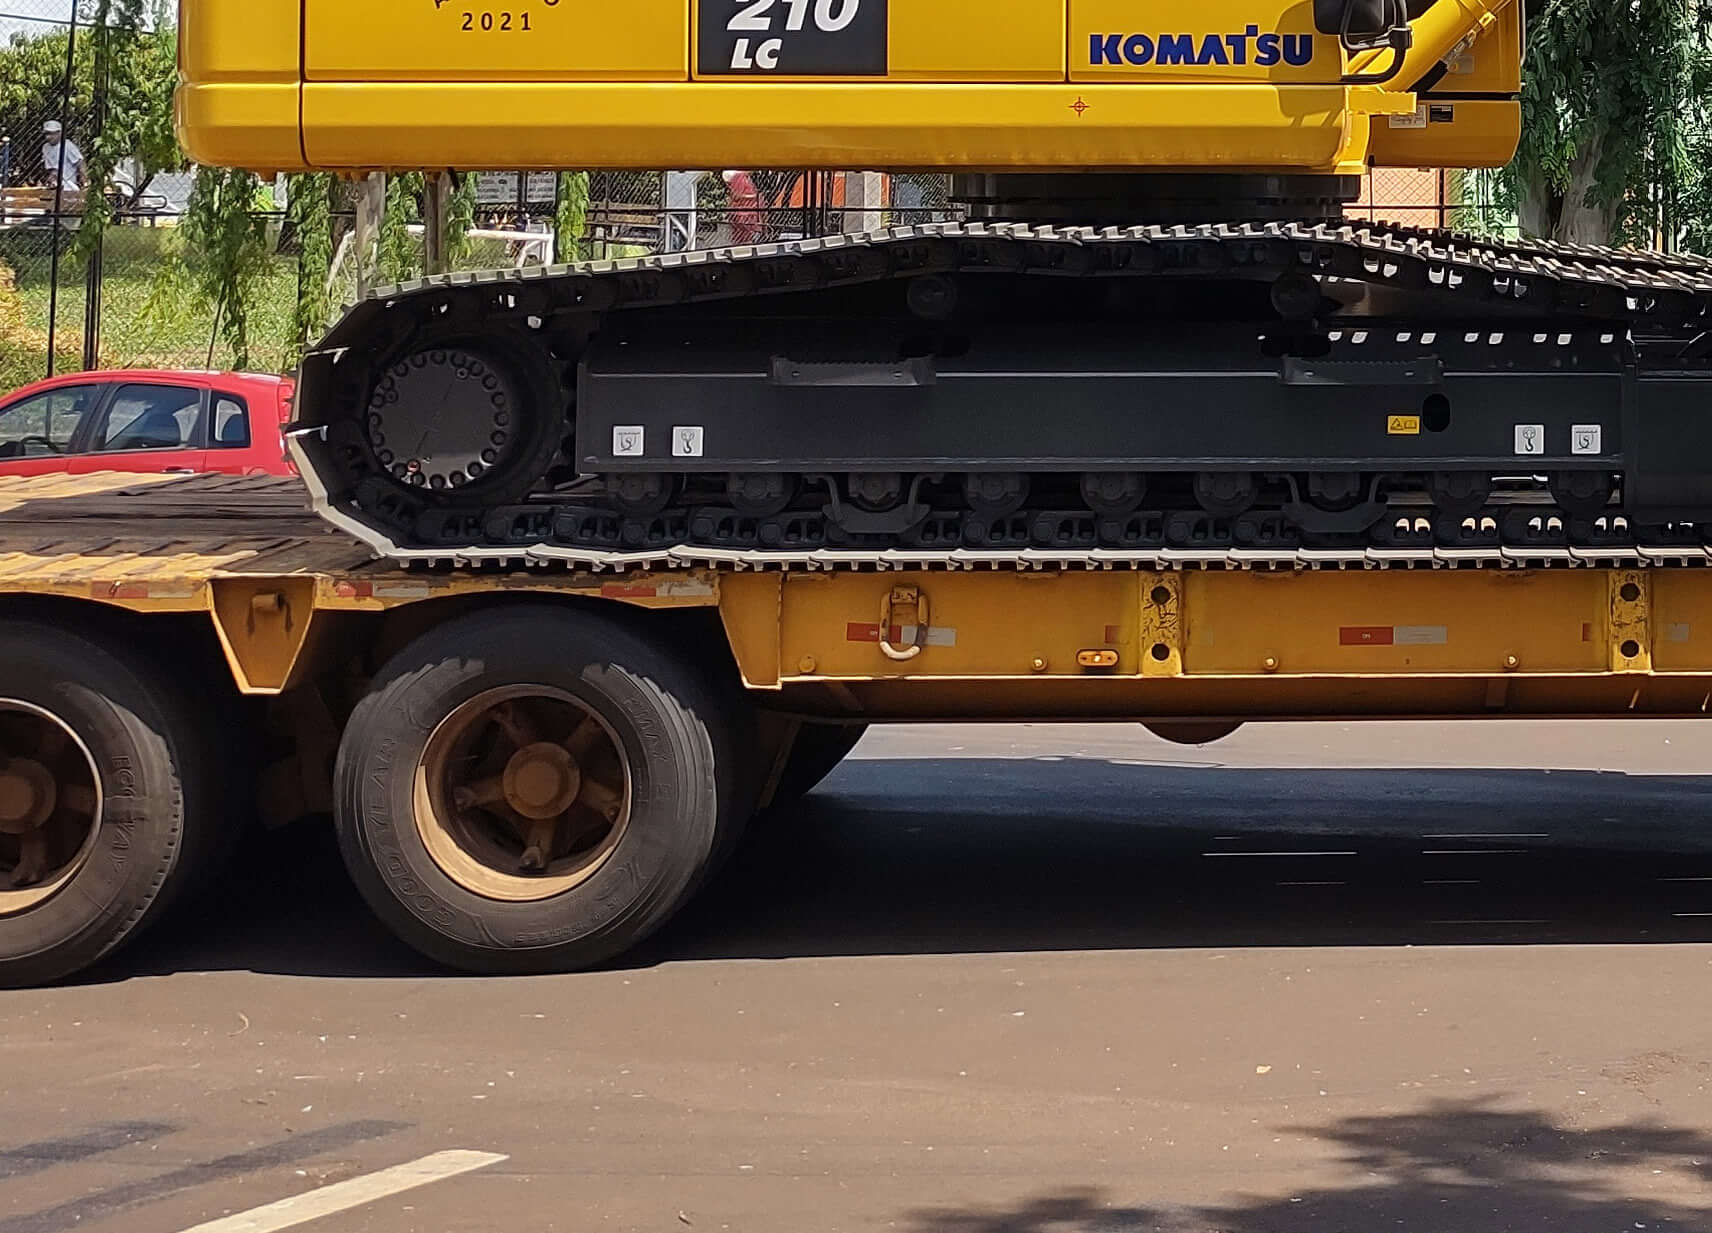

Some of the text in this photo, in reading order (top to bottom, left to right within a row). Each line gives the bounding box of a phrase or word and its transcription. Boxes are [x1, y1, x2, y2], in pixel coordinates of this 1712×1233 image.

[461, 11, 532, 32] 2021
[730, 38, 783, 70] LC
[1089, 24, 1313, 66] KOMATSU
